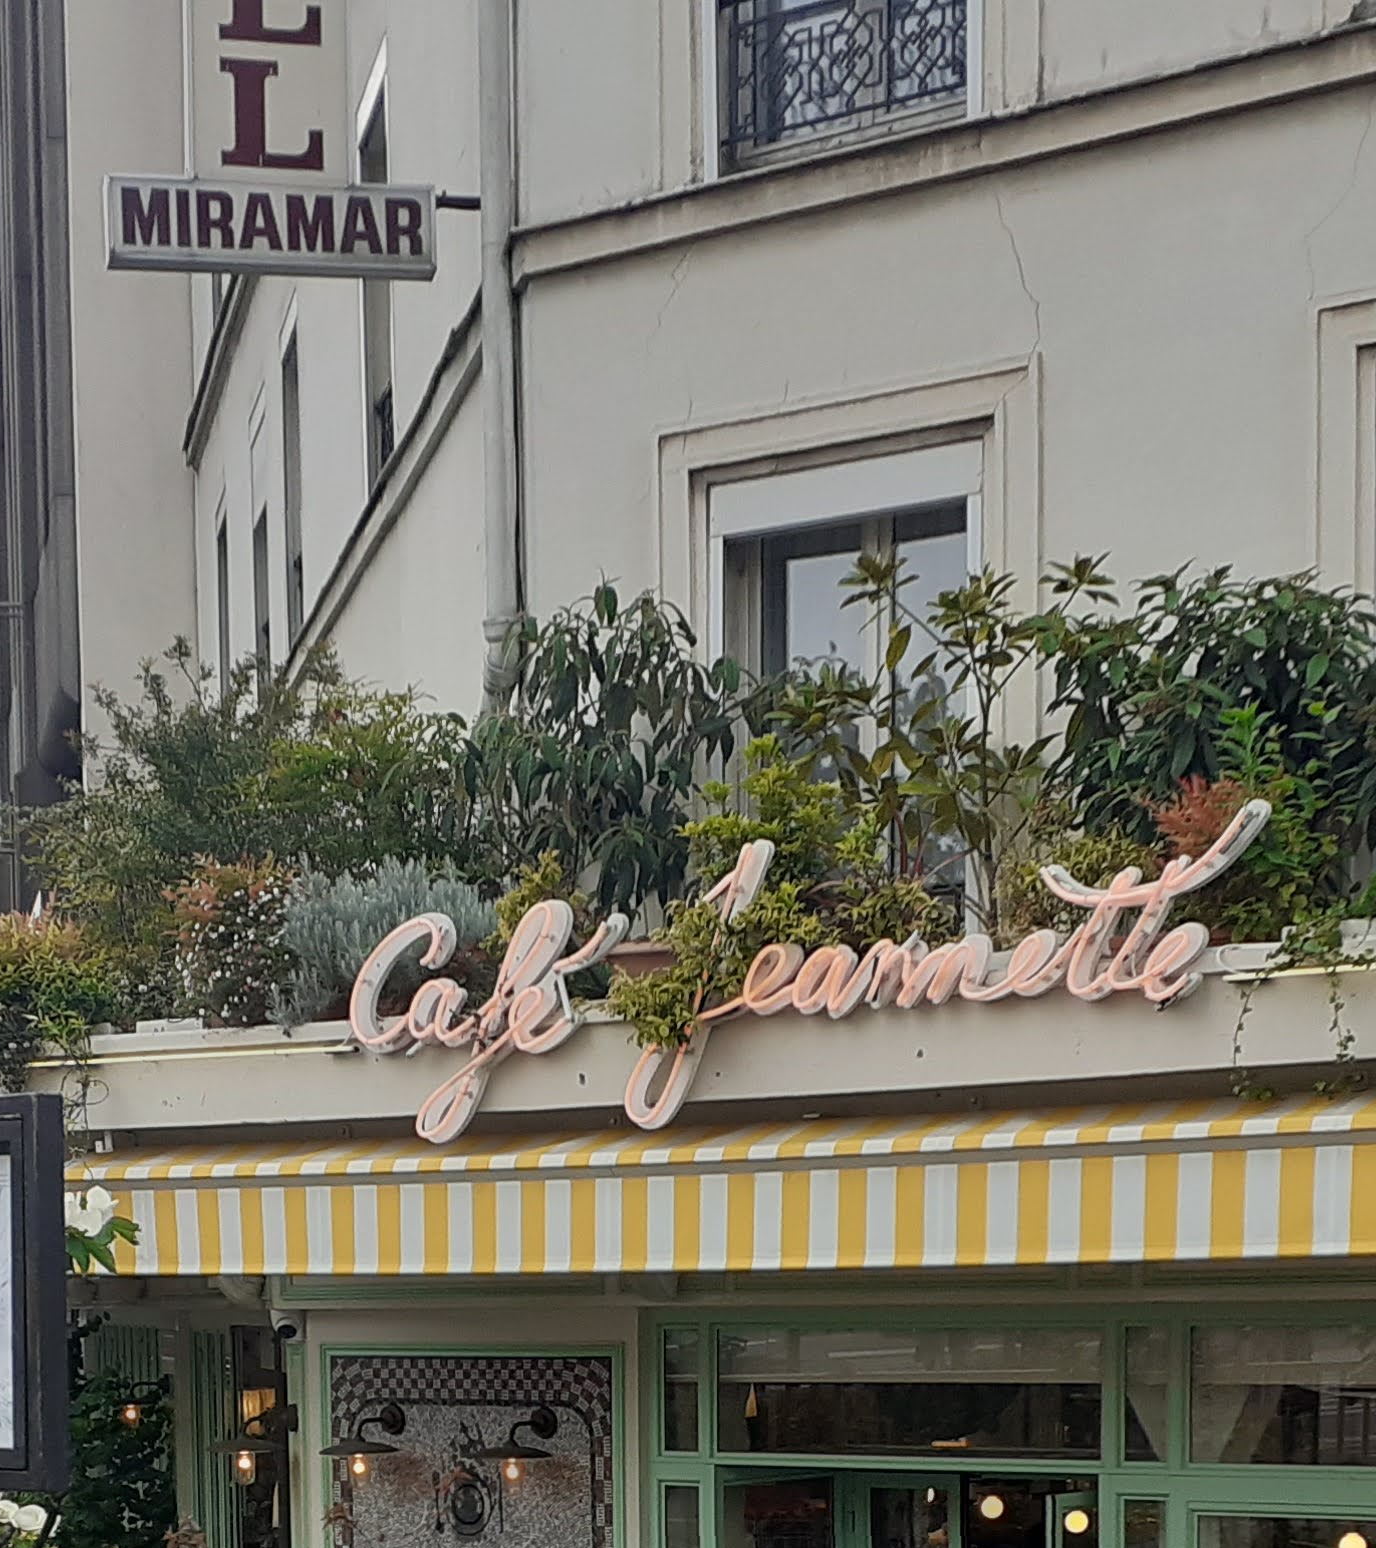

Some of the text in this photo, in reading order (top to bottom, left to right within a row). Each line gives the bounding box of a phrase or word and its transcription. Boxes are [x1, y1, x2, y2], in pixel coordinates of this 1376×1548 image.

[120, 186, 424, 256] MIRAMAR
[348, 798, 1272, 1144] Café Jeannette
